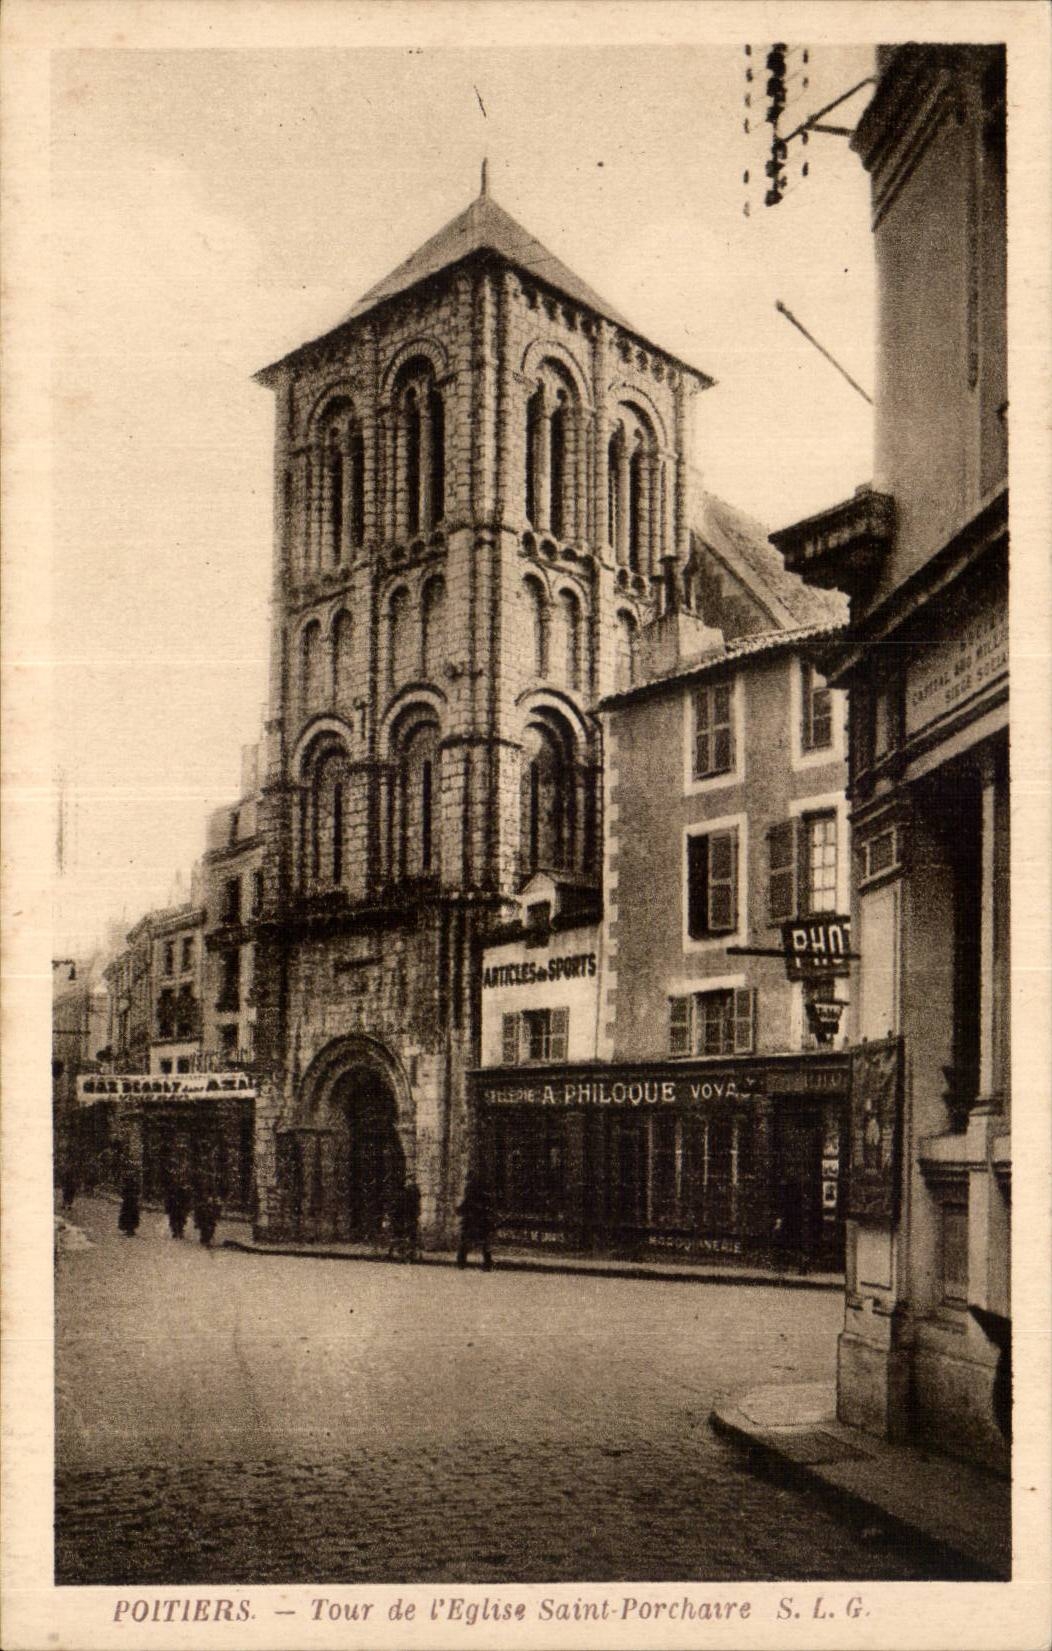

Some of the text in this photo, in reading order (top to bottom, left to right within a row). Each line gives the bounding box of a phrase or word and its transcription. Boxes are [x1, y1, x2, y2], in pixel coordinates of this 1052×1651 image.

[792, 923, 851, 968] PHO
[483, 962, 536, 989] ARTICLES
[548, 952, 597, 982] SPORTS
[564, 1082, 676, 1105] PHILOQUE
